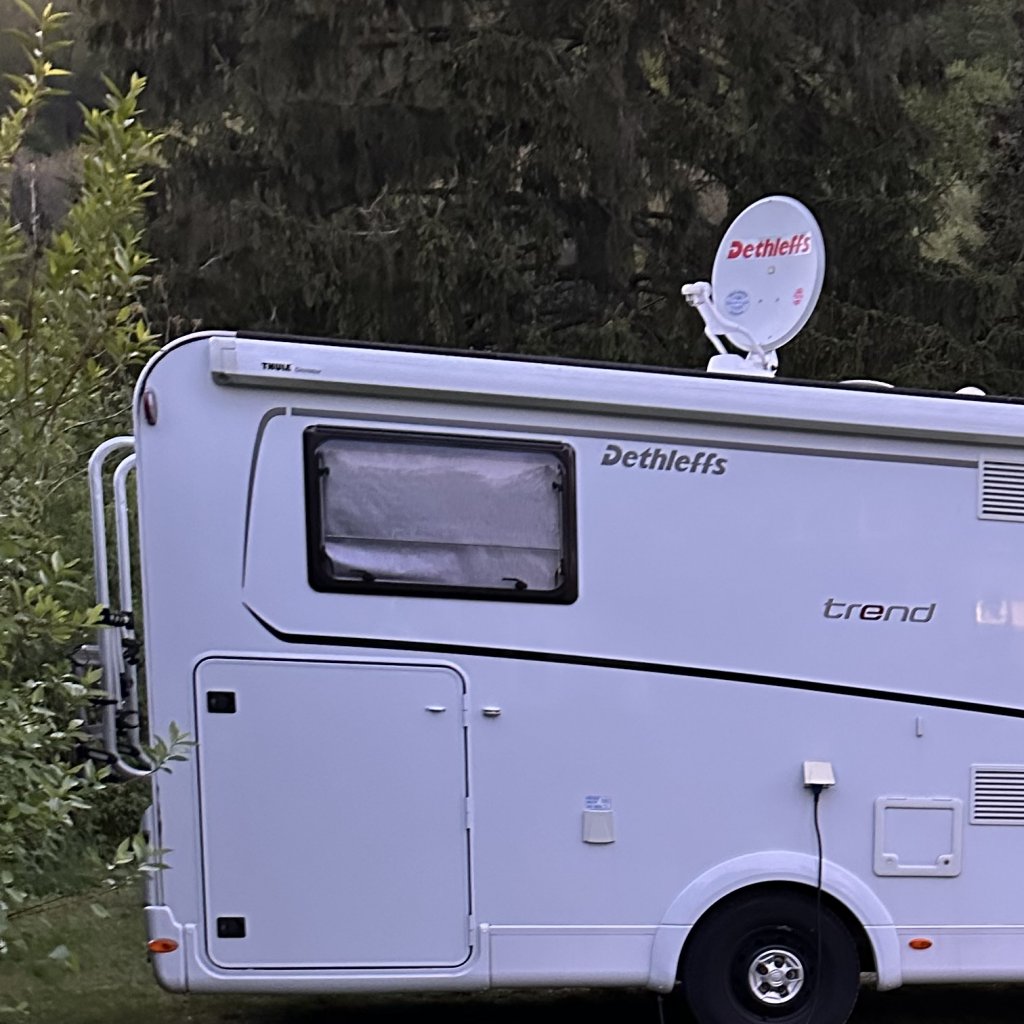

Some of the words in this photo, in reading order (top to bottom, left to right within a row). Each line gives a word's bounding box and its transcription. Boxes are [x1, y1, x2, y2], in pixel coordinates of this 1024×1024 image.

[727, 233, 812, 260] Dethleffs
[261, 362, 292, 372] THULE
[600, 444, 729, 476] Dethleffs
[823, 598, 937, 623] trend
